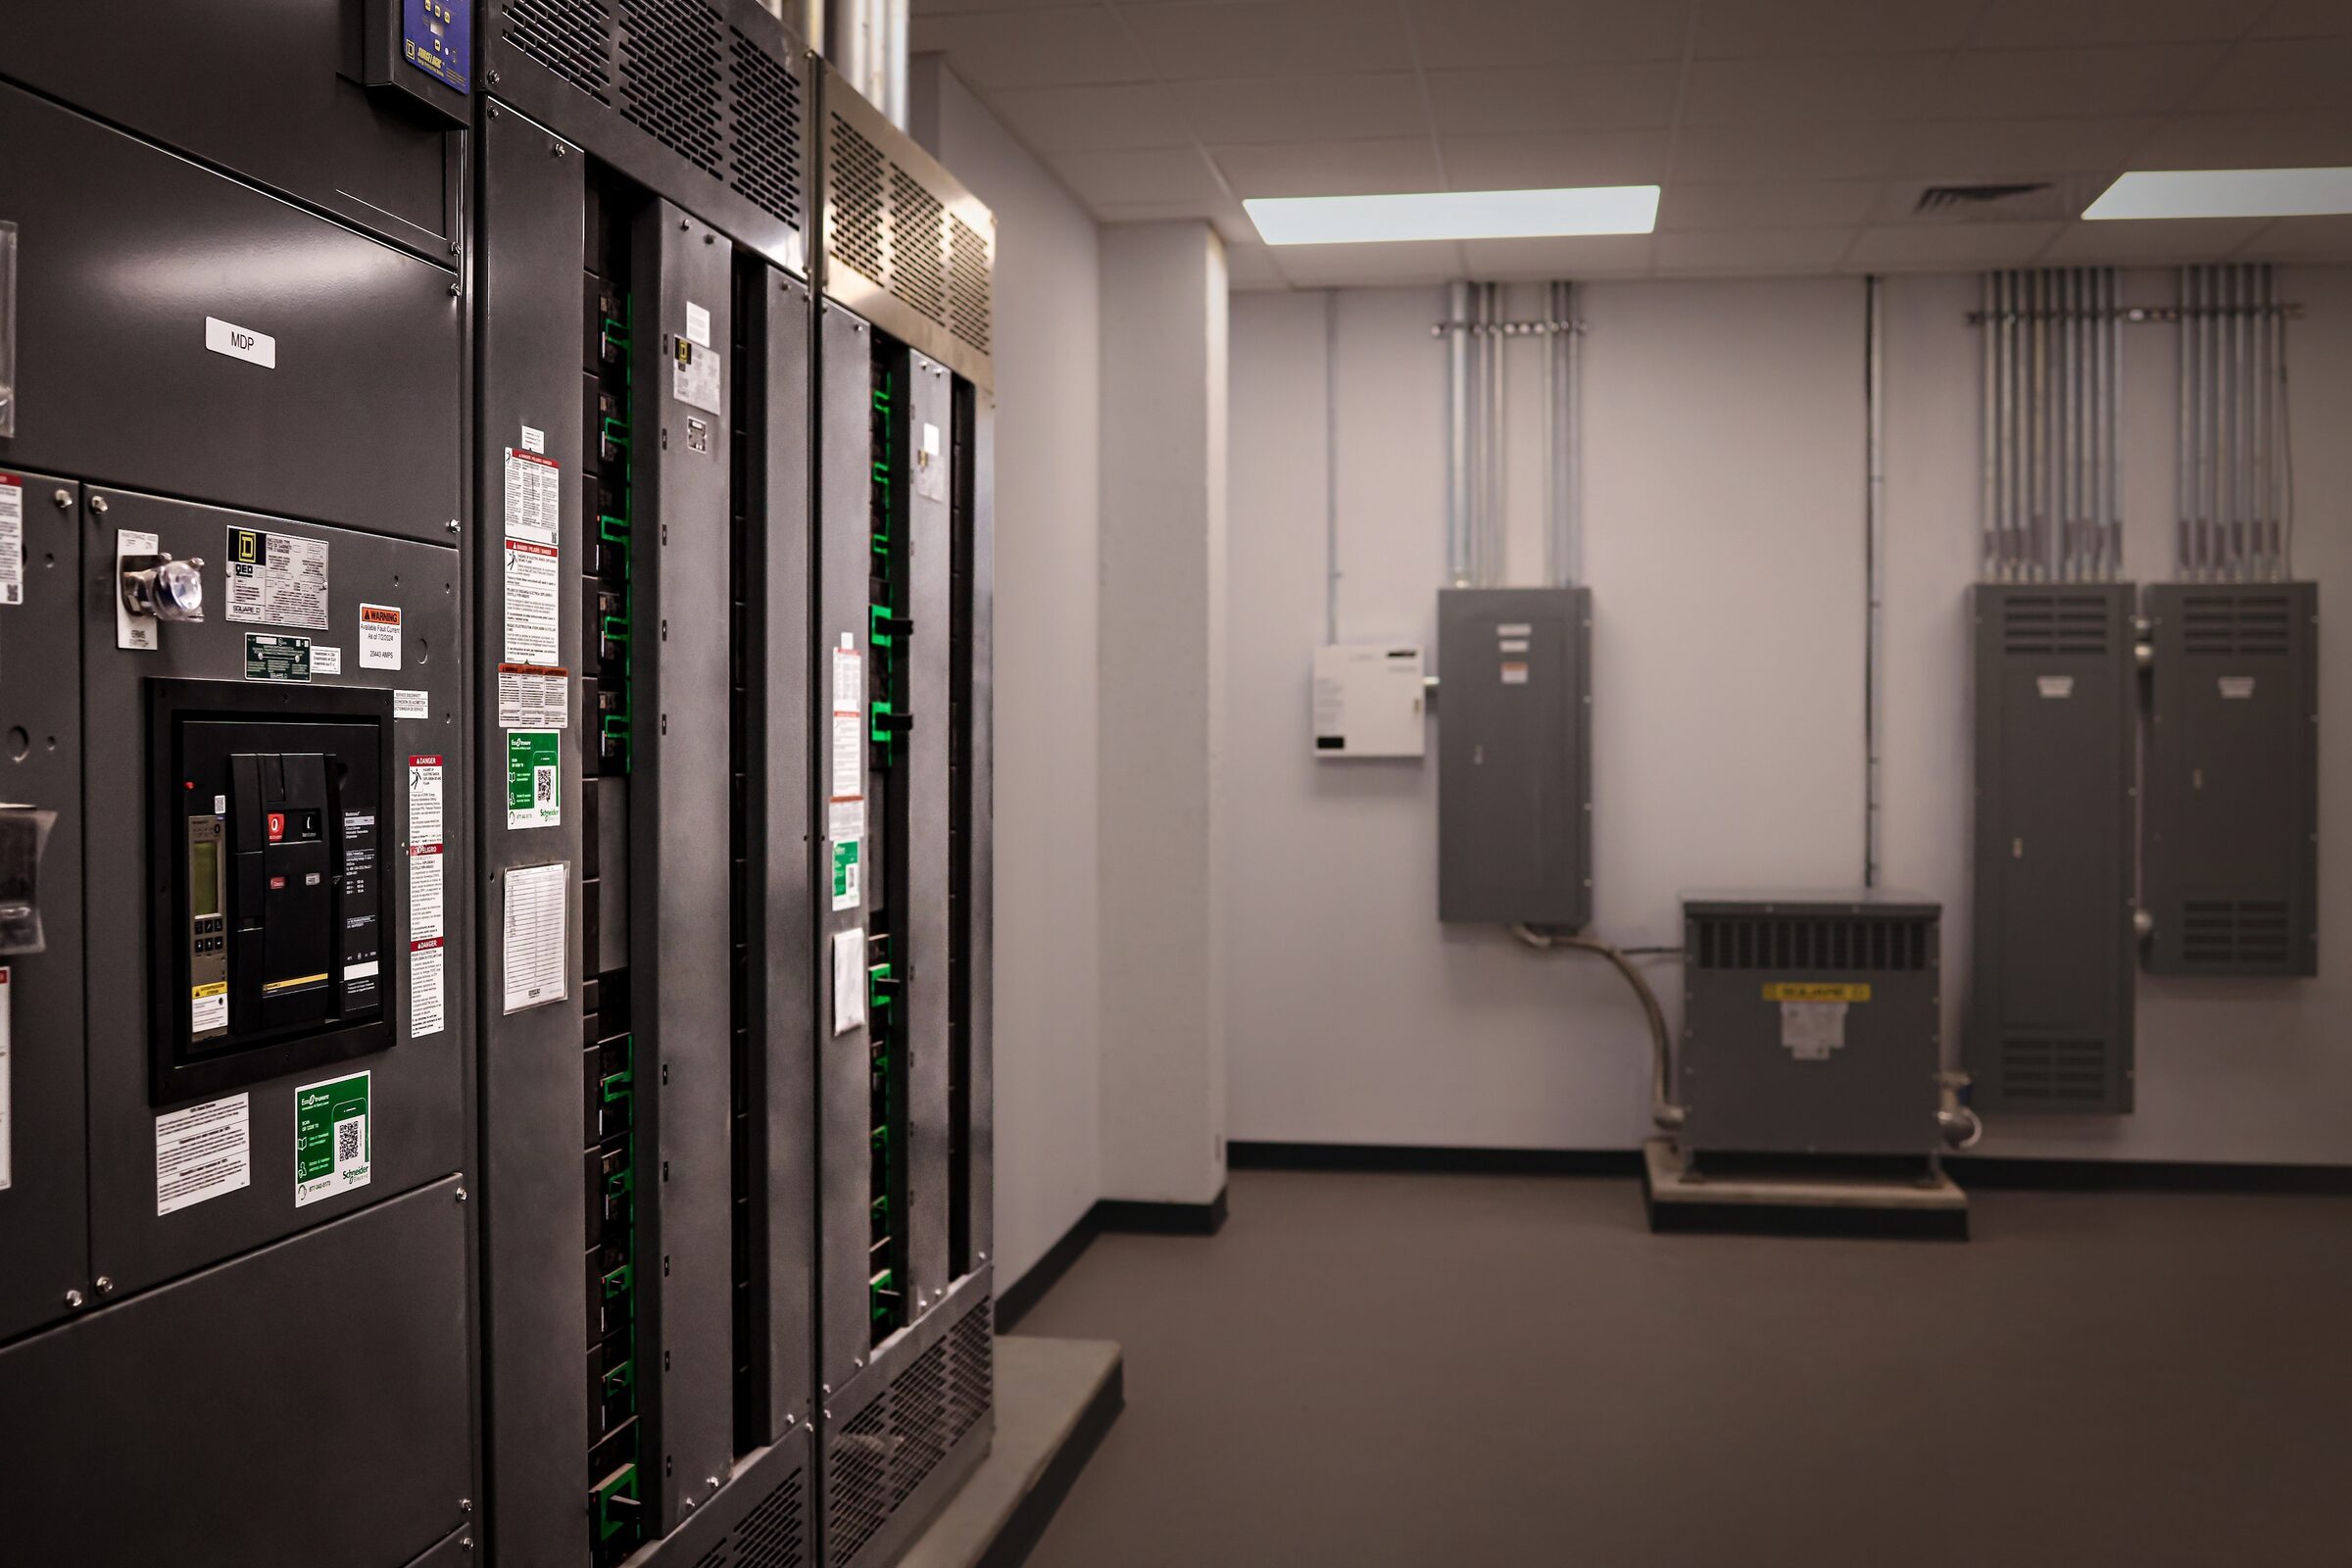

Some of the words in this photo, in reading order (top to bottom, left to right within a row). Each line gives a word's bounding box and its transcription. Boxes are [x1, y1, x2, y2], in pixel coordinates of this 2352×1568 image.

[231, 332, 254, 352] MDP
[233, 605, 254, 613] SQUARE
[371, 611, 397, 622] WARNING
[387, 625, 400, 634] Current
[420, 940, 437, 949] DANGER
[343, 1165, 368, 1180] Schneider
